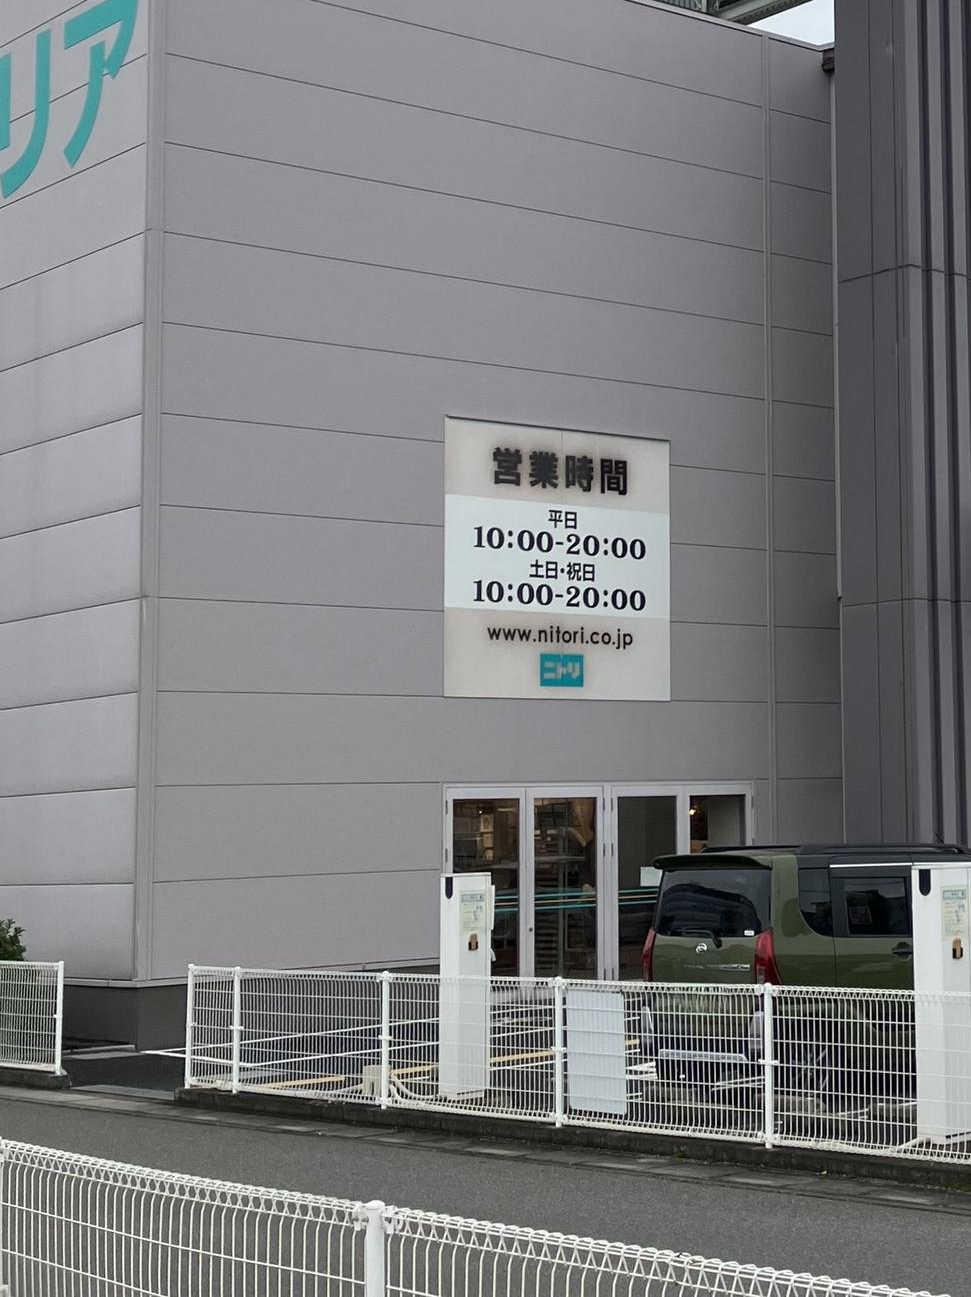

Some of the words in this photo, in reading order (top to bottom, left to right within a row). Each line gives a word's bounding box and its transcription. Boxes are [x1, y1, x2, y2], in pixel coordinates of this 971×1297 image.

[492, 447, 628, 496] 営業時間
[548, 509, 578, 530] 平日
[473, 526, 646, 560] 10:00-20:00
[529, 559, 596, 582] 土日・祝日
[473, 580, 646, 611] 10:00-20:00
[487, 625, 634, 650] www.nitori.co.jp
[543, 660, 581, 681] ニトリ
